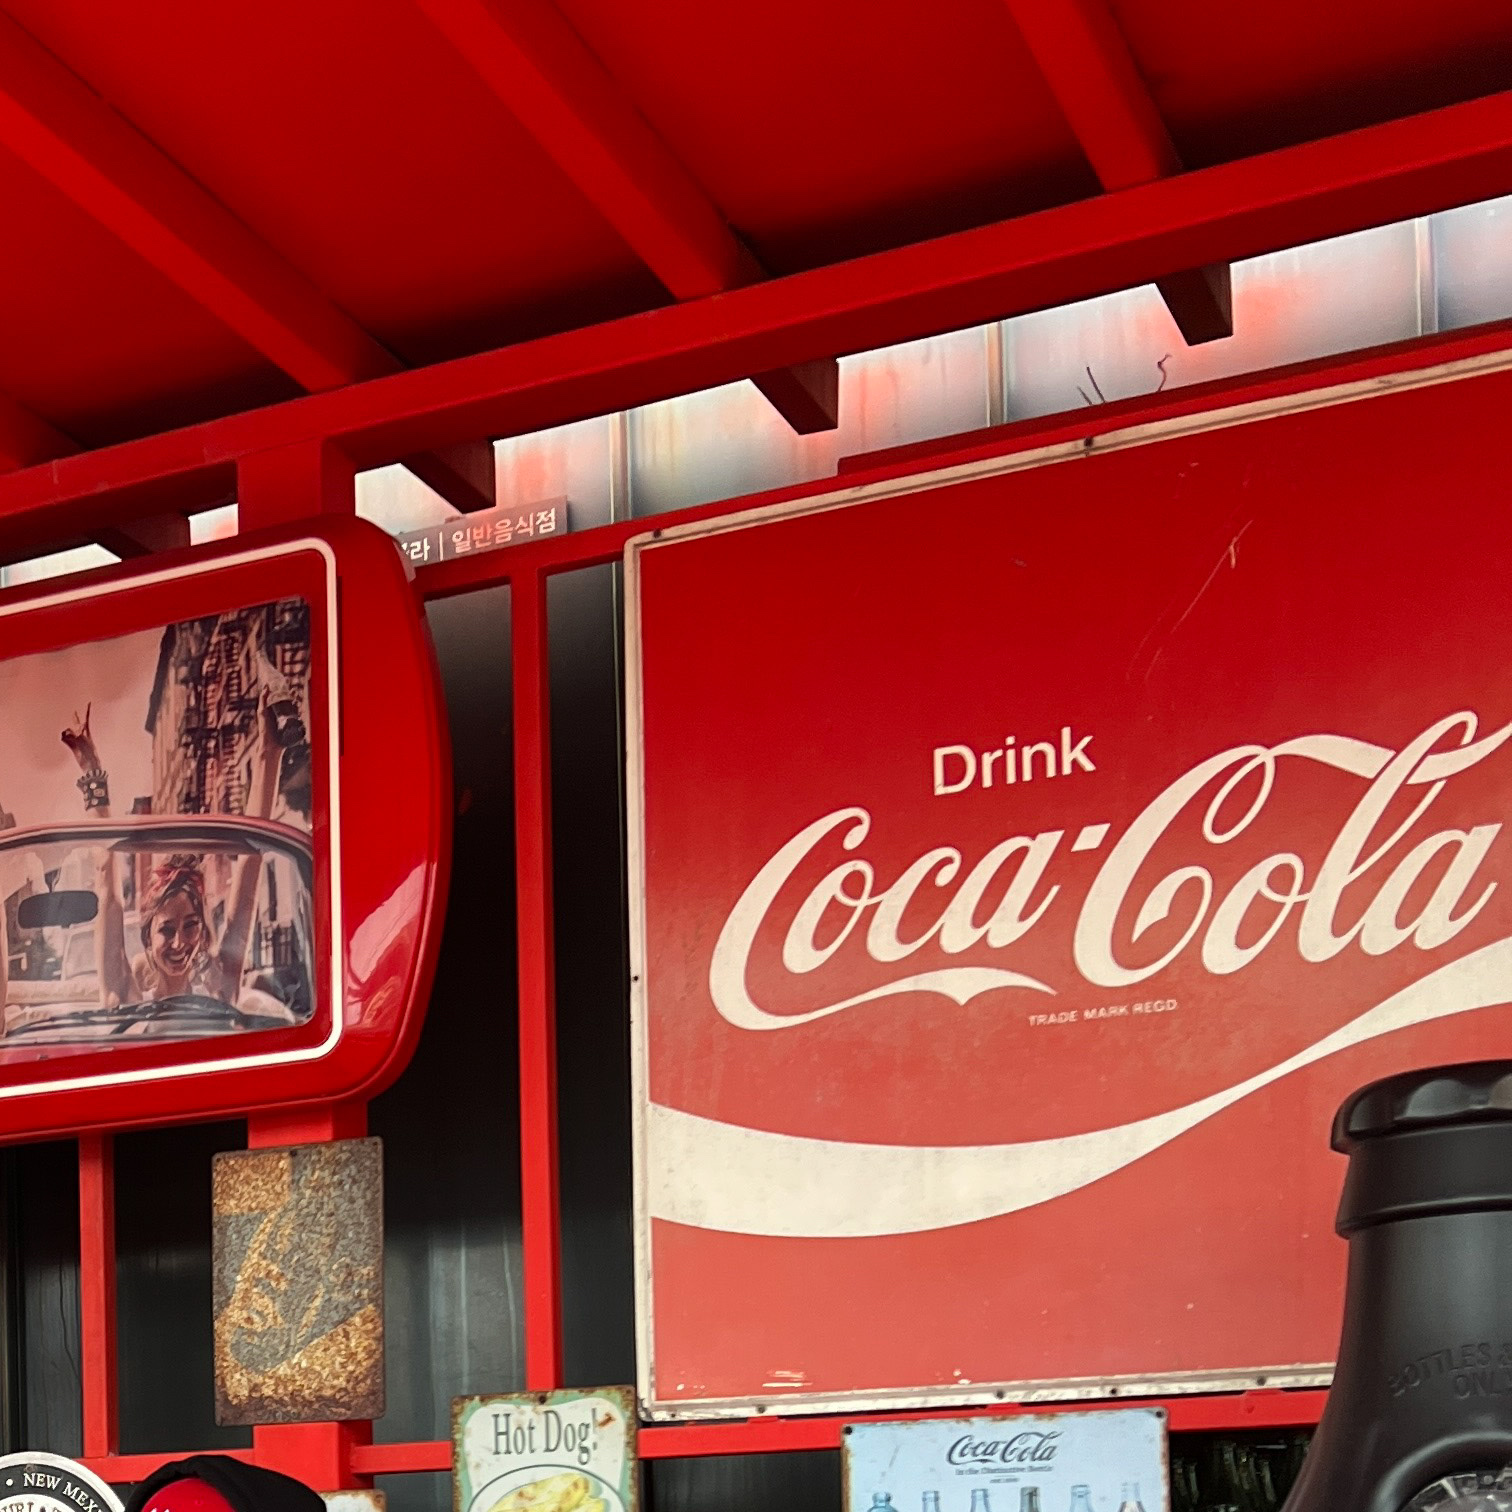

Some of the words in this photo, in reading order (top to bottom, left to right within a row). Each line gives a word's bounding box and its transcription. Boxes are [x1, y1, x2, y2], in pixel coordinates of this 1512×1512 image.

[451, 507, 557, 554] 일반음식점
[933, 726, 1097, 796] Drink
[708, 708, 1512, 1032] Coca-Cola
[1028, 1010, 1078, 1027] TRADE
[1083, 1005, 1129, 1020] MARK
[491, 1412, 535, 1455] Hot
[543, 1407, 598, 1466] Dog!
[946, 1431, 1065, 1466] Coca-Cola
[22, 1473, 62, 1490] NEW
